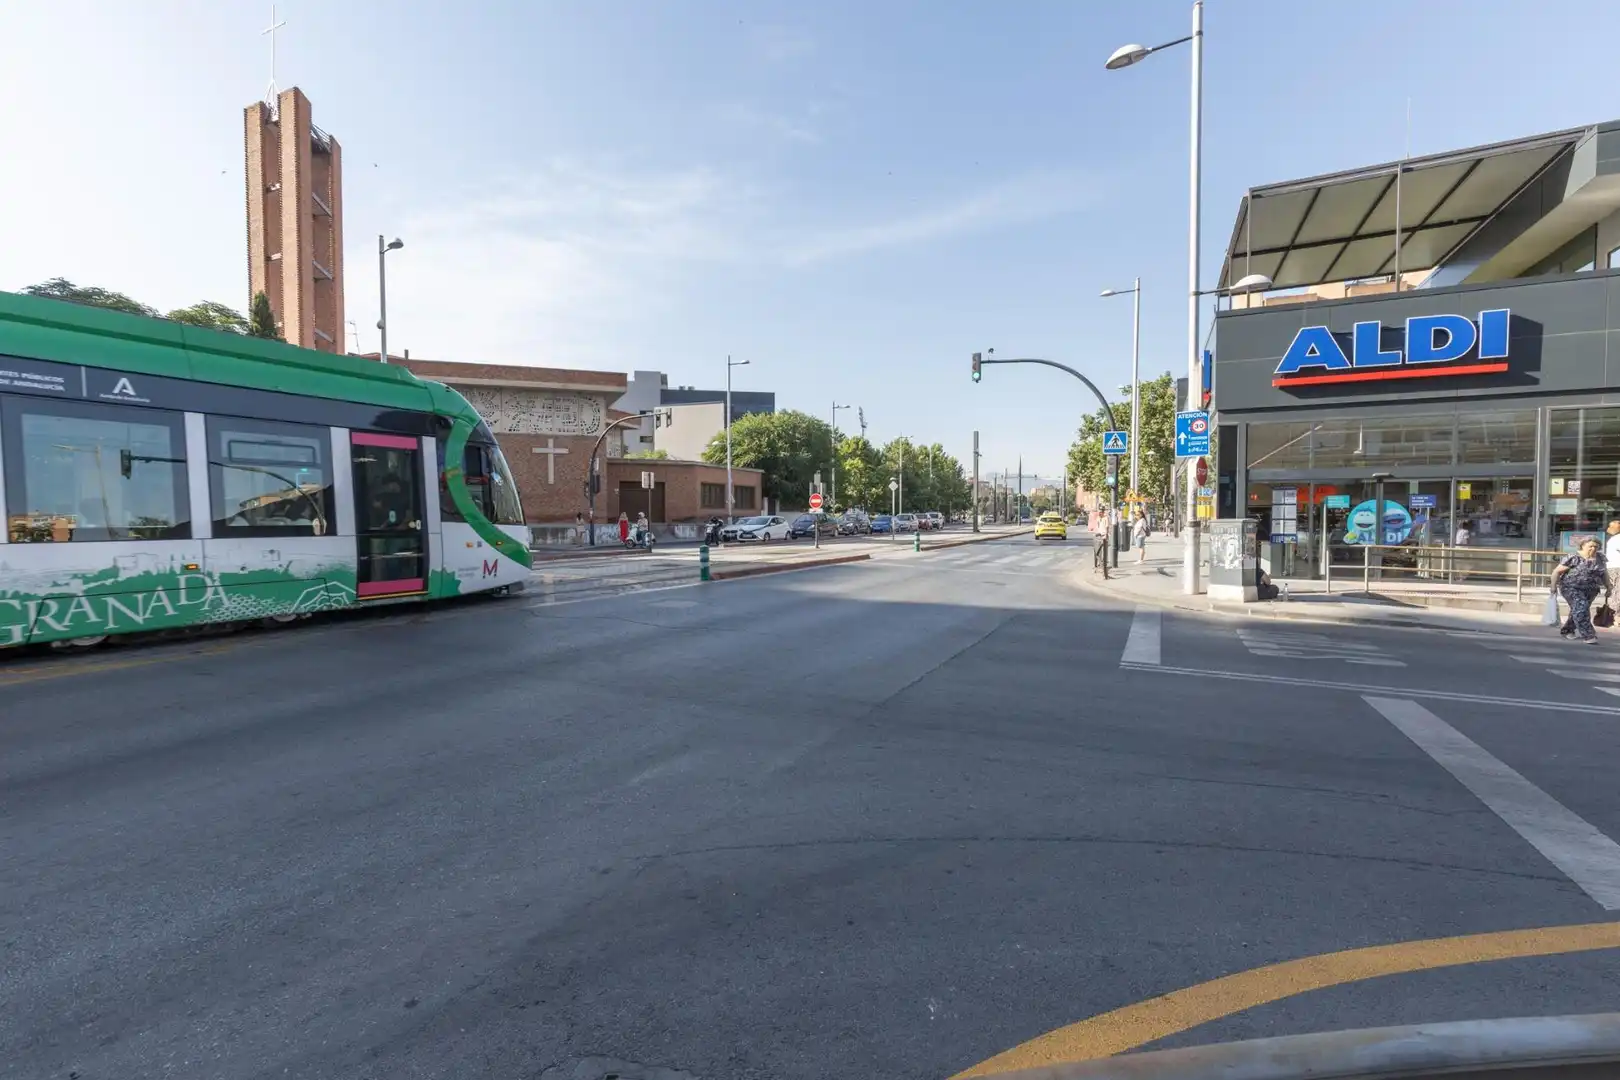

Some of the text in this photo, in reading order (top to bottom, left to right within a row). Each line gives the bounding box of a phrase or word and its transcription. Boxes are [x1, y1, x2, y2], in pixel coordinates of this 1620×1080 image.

[1274, 308, 1510, 374] ALDI
[1177, 411, 1208, 419] ATENCIÓN
[1194, 422, 1204, 430] 30
[482, 558, 499, 579] M
[0, 572, 230, 647] GRANADA
